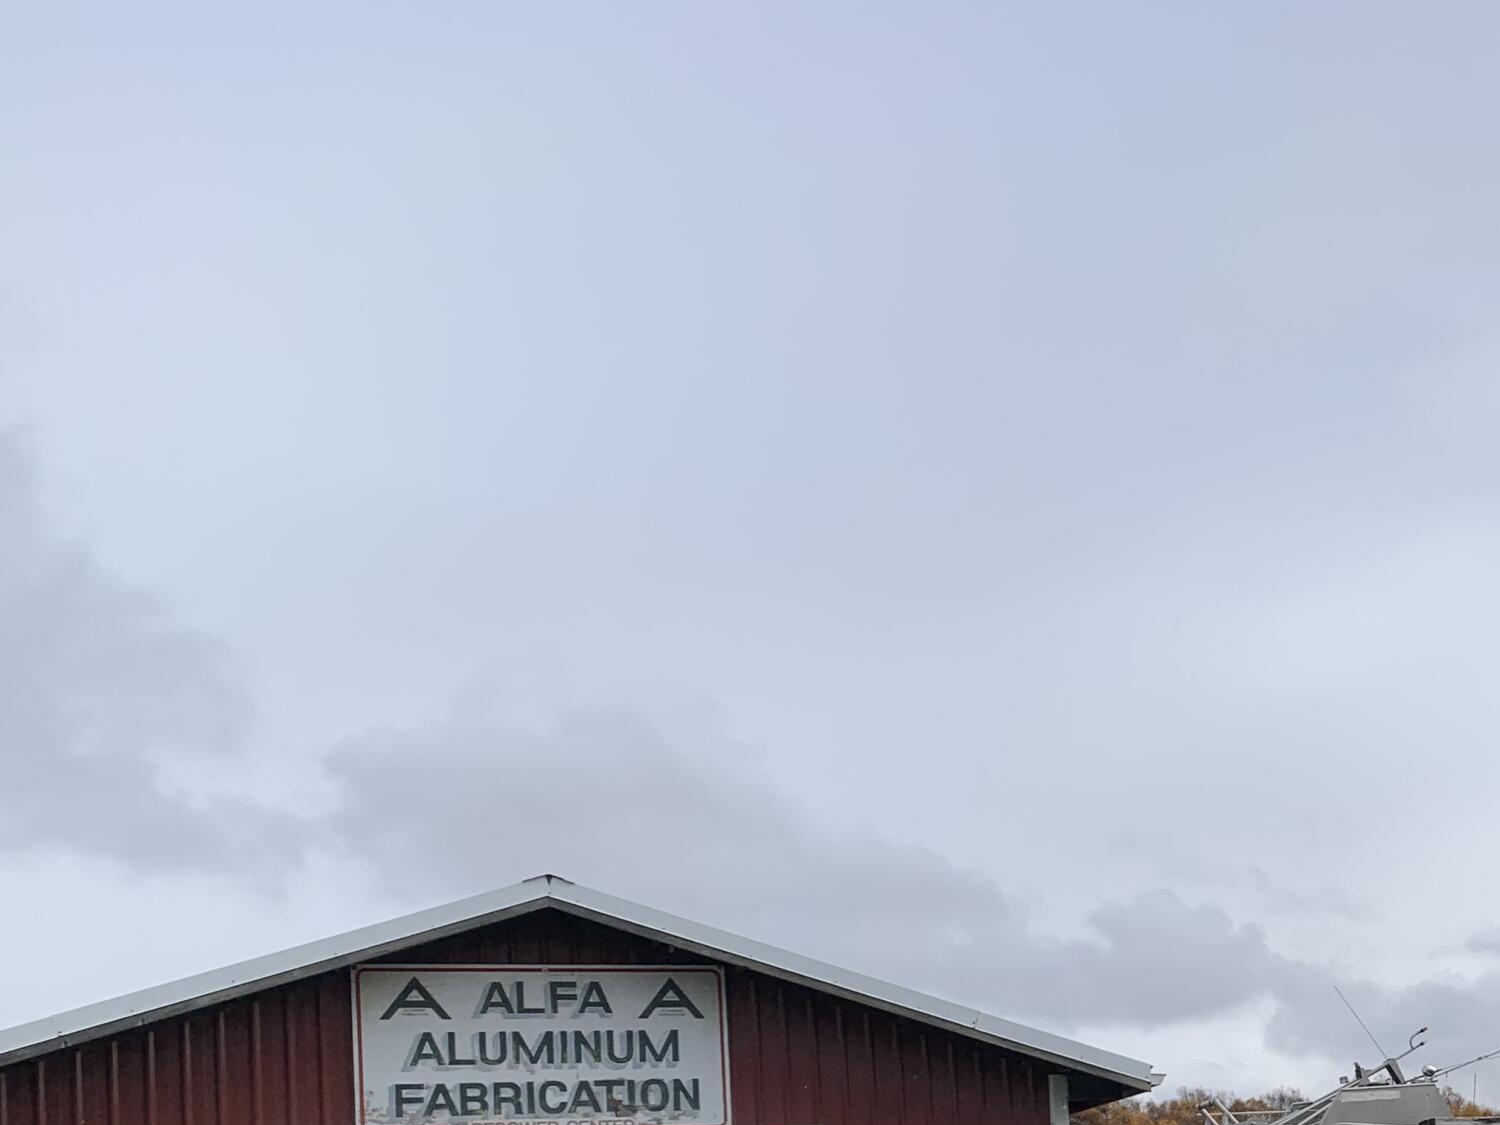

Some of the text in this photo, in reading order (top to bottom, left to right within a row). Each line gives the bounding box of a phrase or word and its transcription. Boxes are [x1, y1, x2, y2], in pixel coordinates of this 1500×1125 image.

[479, 980, 614, 1015] ALFA
[409, 1029, 680, 1067] ALUMINUM
[394, 1078, 701, 1118] FABRICATION
